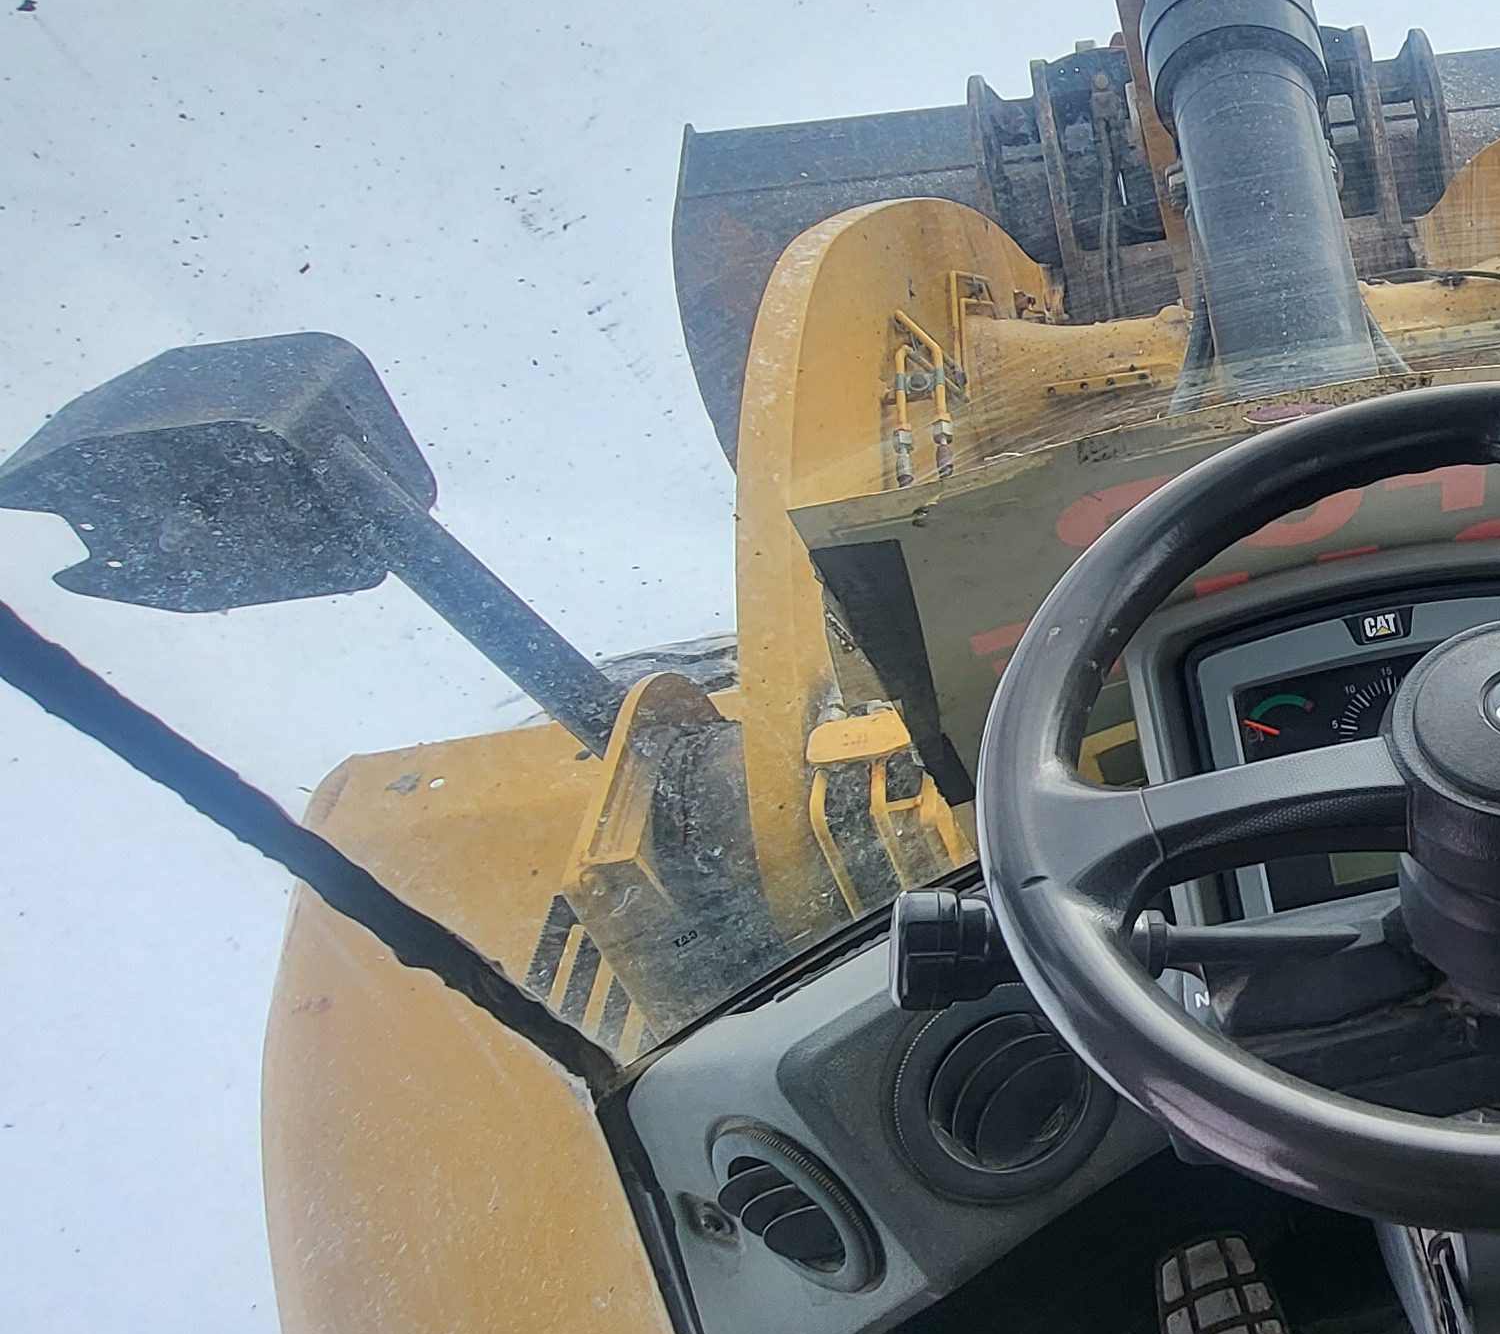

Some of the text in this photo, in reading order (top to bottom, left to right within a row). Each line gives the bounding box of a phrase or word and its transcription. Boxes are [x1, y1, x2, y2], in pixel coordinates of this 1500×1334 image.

[1363, 613, 1396, 638] CAT
[1382, 667, 1393, 677] 15
[1344, 685, 1356, 695] 10
[1331, 720, 1339, 729] 5
[1194, 991, 1210, 1008] N
